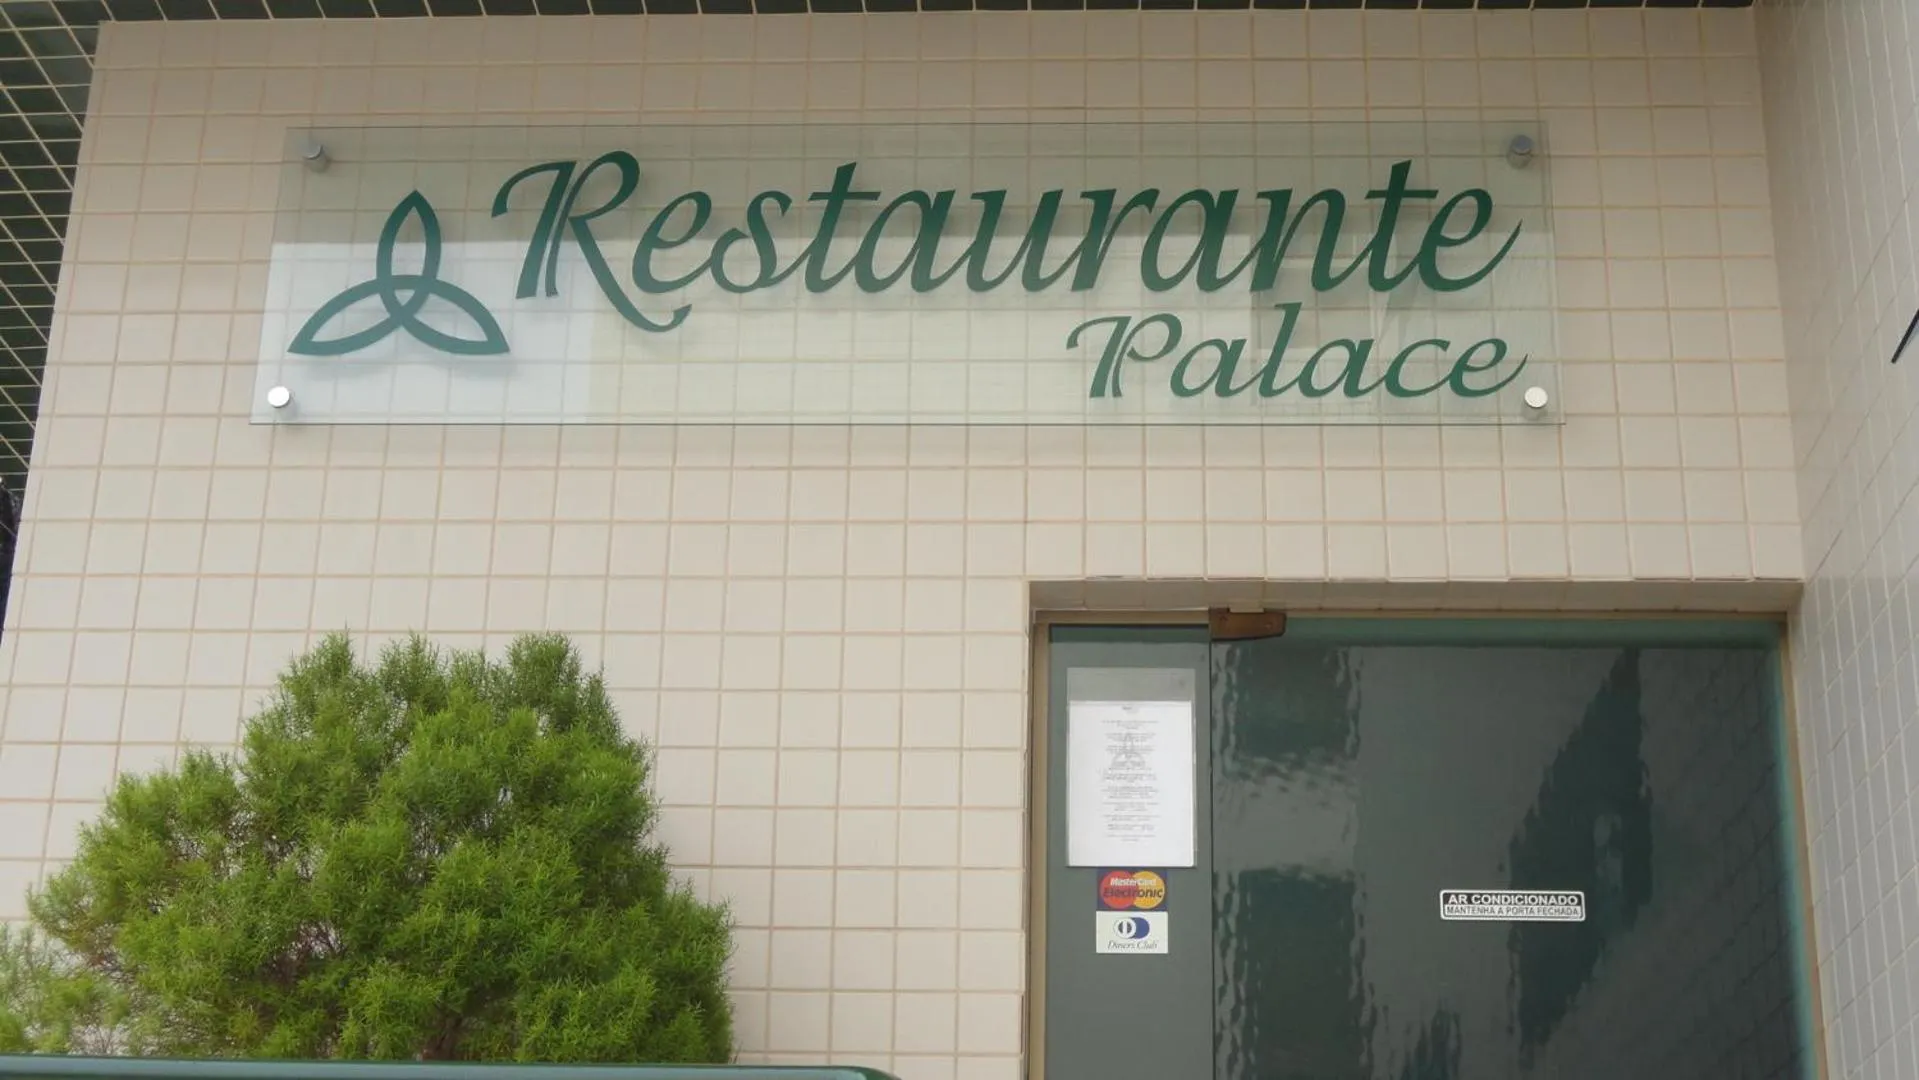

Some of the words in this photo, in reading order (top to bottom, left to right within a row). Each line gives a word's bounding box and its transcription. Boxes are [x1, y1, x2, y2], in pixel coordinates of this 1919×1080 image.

[491, 150, 1523, 333] Restaurante
[1066, 302, 1528, 398] Palace
[1449, 894, 1468, 905] AR
[1472, 894, 1578, 906] CONDICIONADO
[1446, 905, 1495, 916] MANTENHA
[1497, 906, 1504, 916] A
[1506, 906, 1535, 916] PORTA
[1537, 906, 1579, 917] FECHADA
[1107, 940, 1135, 950] Diners
[1137, 940, 1158, 950] Club
